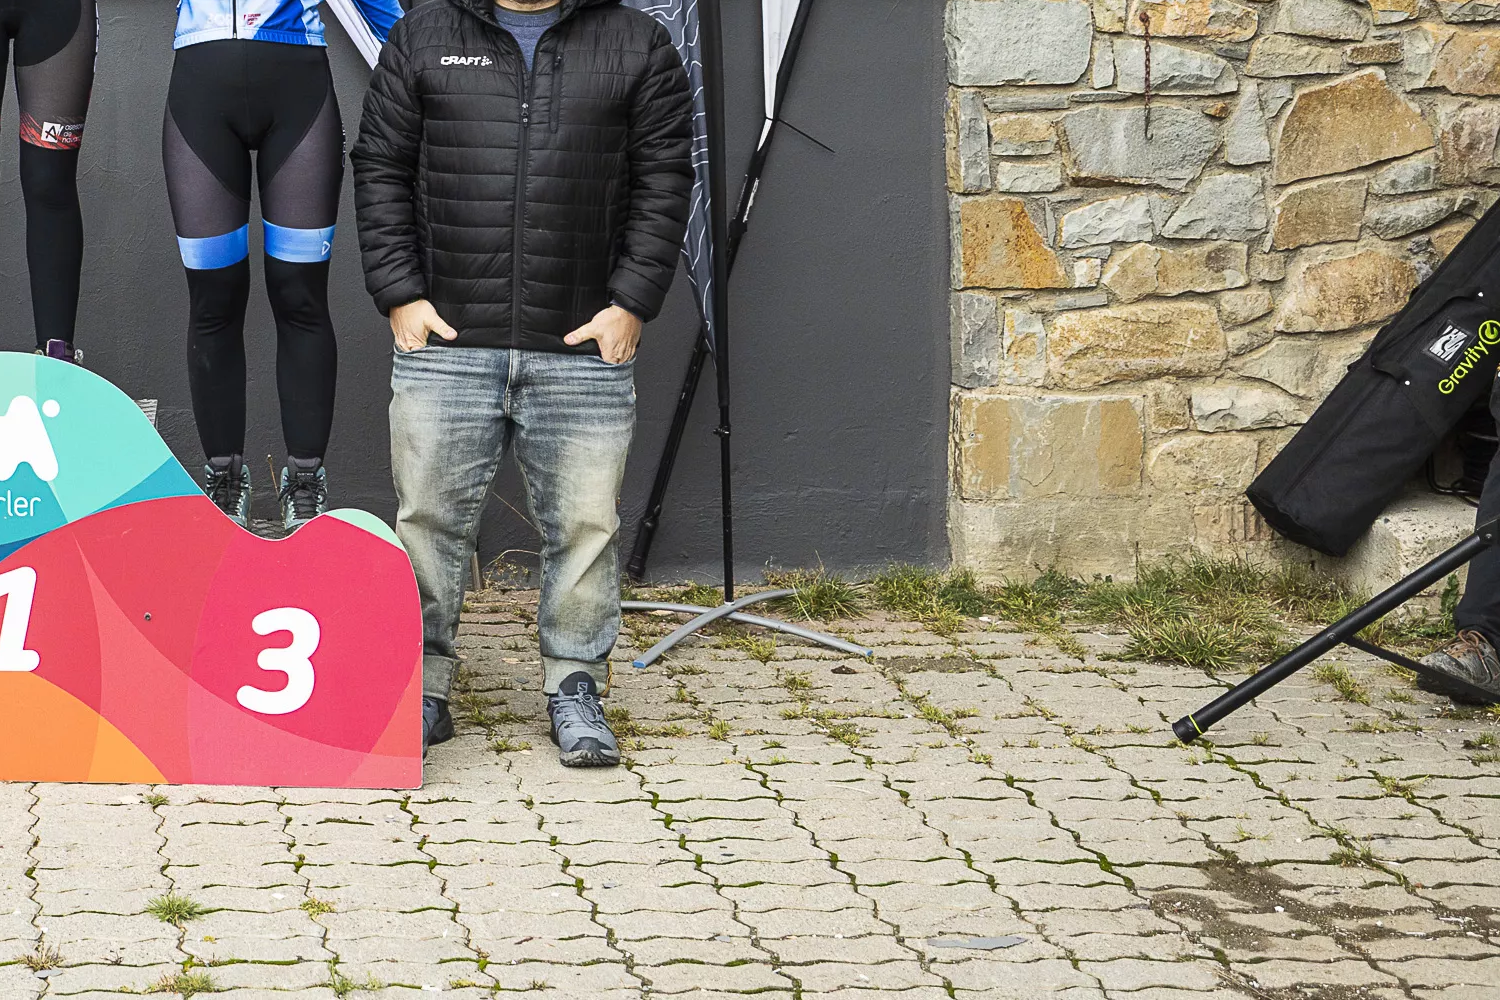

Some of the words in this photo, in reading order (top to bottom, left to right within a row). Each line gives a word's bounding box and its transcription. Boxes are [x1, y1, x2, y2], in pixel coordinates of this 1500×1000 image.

[440, 55, 481, 67] CRAFT
[1438, 340, 1490, 395] Gravity
[235, 606, 322, 716] 3
